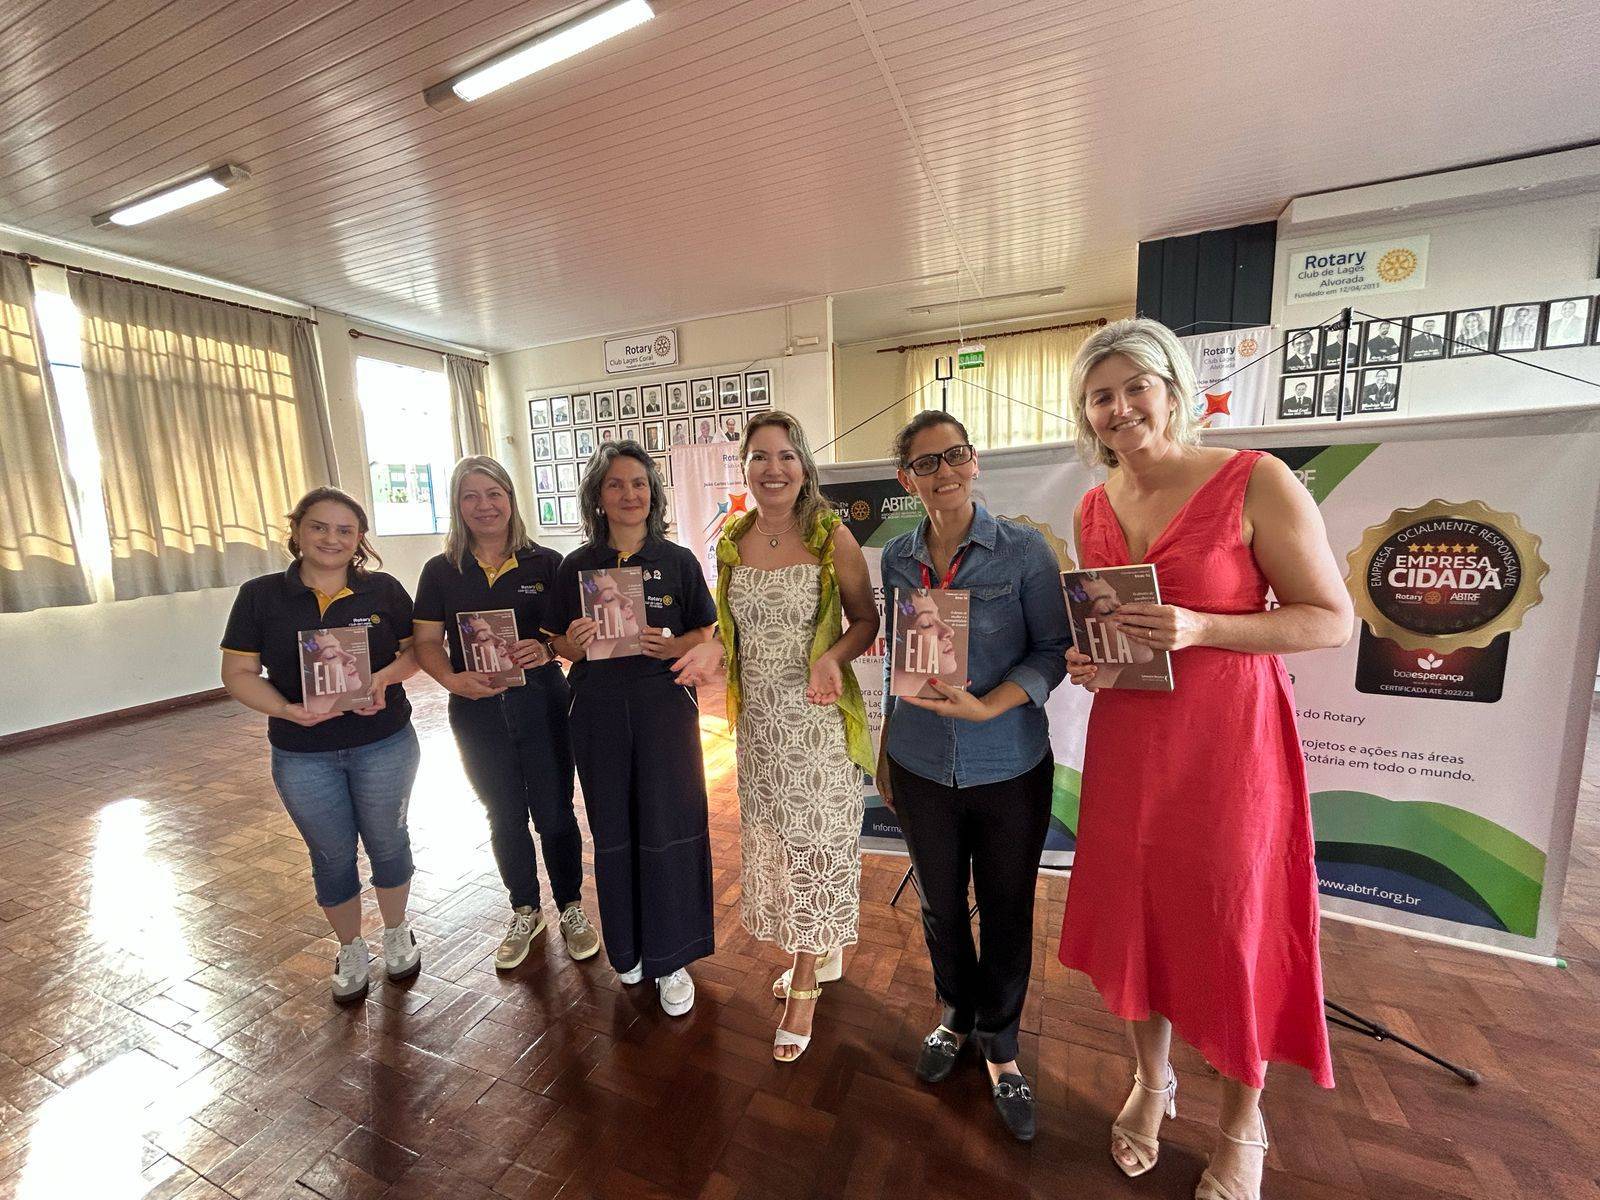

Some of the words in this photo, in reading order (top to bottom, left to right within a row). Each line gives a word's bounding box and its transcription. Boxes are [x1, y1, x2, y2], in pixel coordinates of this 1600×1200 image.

[1305, 251, 1367, 270] Rotary
[1298, 270, 1319, 280] Club
[1321, 268, 1334, 277] de
[1337, 264, 1365, 276] Lages
[1320, 275, 1364, 288] Alvorada
[1294, 289, 1325, 299] Fundado
[1326, 288, 1337, 296] em
[625, 344, 652, 356] Rotary
[1203, 346, 1236, 356] Rotary
[609, 358, 622, 367] Club
[623, 356, 638, 366] Lages
[639, 354, 654, 362] Coral
[1371, 546, 1395, 587] EMPRESA
[1395, 555, 1491, 569] EMPRESA
[1387, 567, 1502, 590] CIDADÃ
[1395, 592, 1423, 601] Rotary
[1450, 592, 1481, 601] ABTRF
[593, 604, 625, 640] ELA
[1085, 617, 1134, 664] ELA
[471, 643, 501, 673] ELA
[904, 629, 940, 674] ELA
[313, 661, 347, 696] ELA
[1393, 670, 1464, 682] boaesperança
[1380, 684, 1428, 694] CERTIFICADA
[1443, 688, 1474, 697] 2022/23
[1303, 708, 1320, 720] do
[1323, 710, 1366, 726] Rotary
[1301, 738, 1346, 752] rojetos
[1360, 745, 1398, 758] ações
[1401, 751, 1424, 761] nas
[1427, 751, 1464, 765] áreas
[1303, 752, 1345, 766] Rotária
[1349, 759, 1369, 769] em
[1373, 762, 1405, 774] todo
[1408, 767, 1417, 775] o
[1420, 768, 1475, 782] mundo.
[1318, 879, 1422, 906] www.abtrf.org.br
